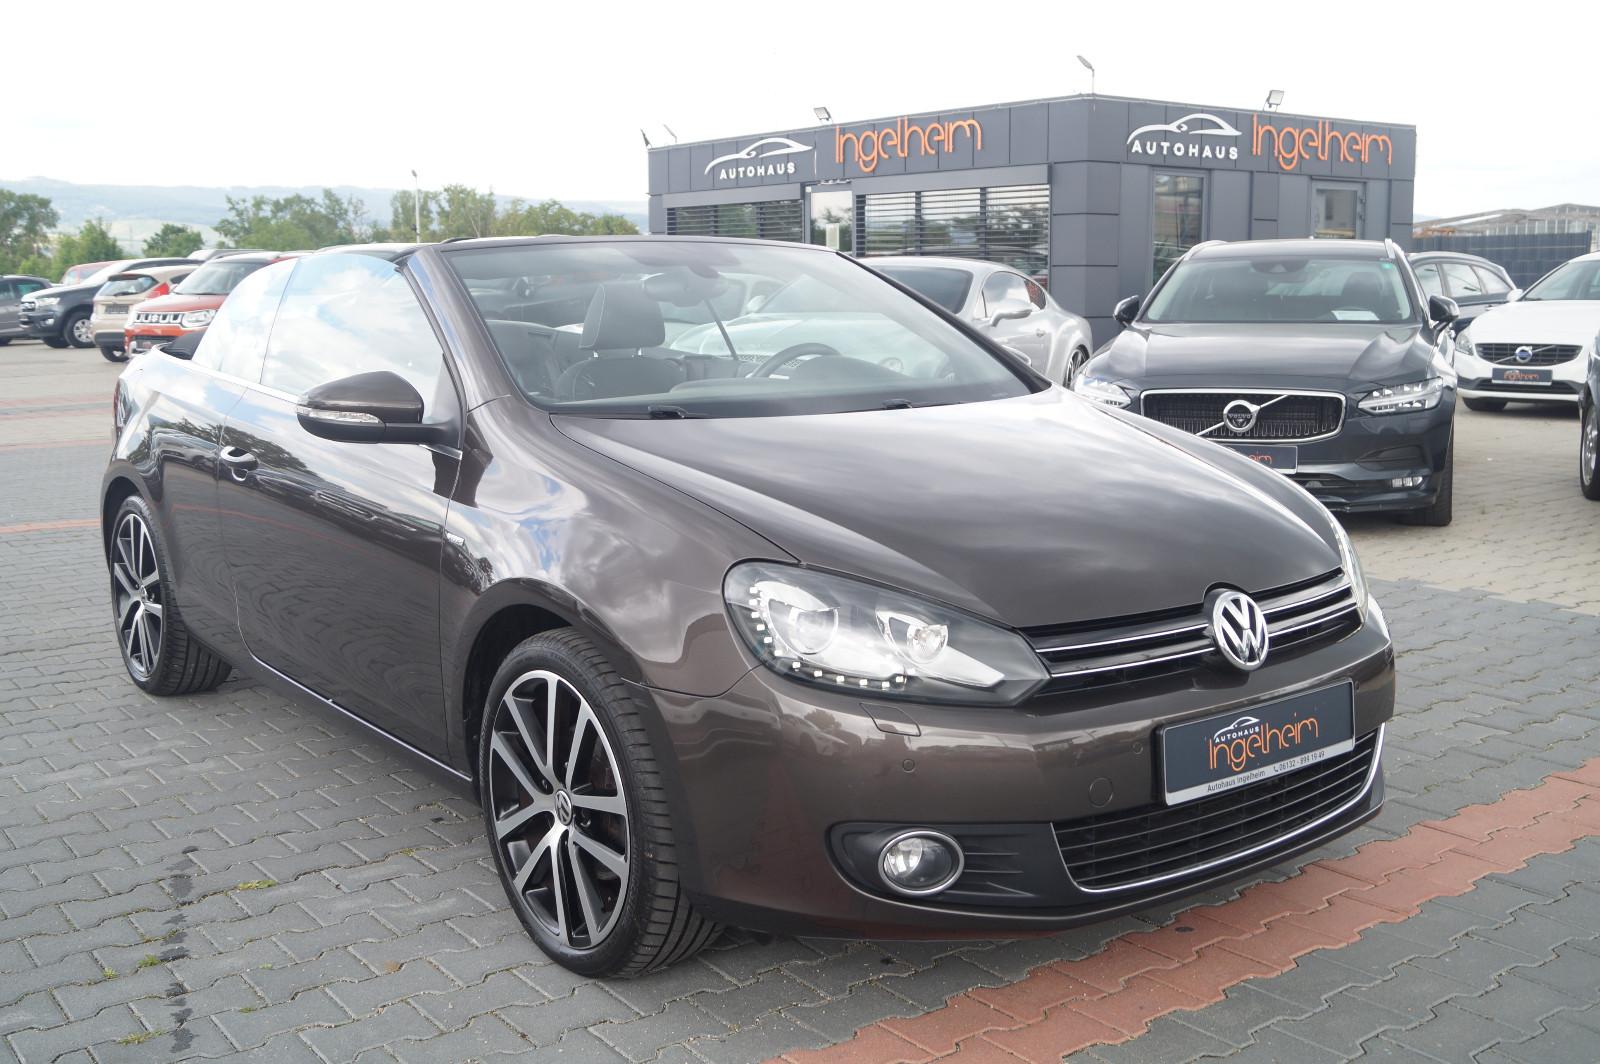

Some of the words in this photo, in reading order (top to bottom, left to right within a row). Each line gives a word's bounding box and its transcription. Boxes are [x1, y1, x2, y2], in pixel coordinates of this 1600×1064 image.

[835, 115, 982, 173] Ingelheim
[1131, 139, 1238, 160] AUTOHAUS
[1252, 112, 1392, 170] Ingelheim
[719, 161, 796, 180] AUTOHAUS
[1208, 714, 1319, 772] Ingelheim
[1215, 726, 1260, 743] AUTOHAUS
[1207, 777, 1236, 793] Autohaus
